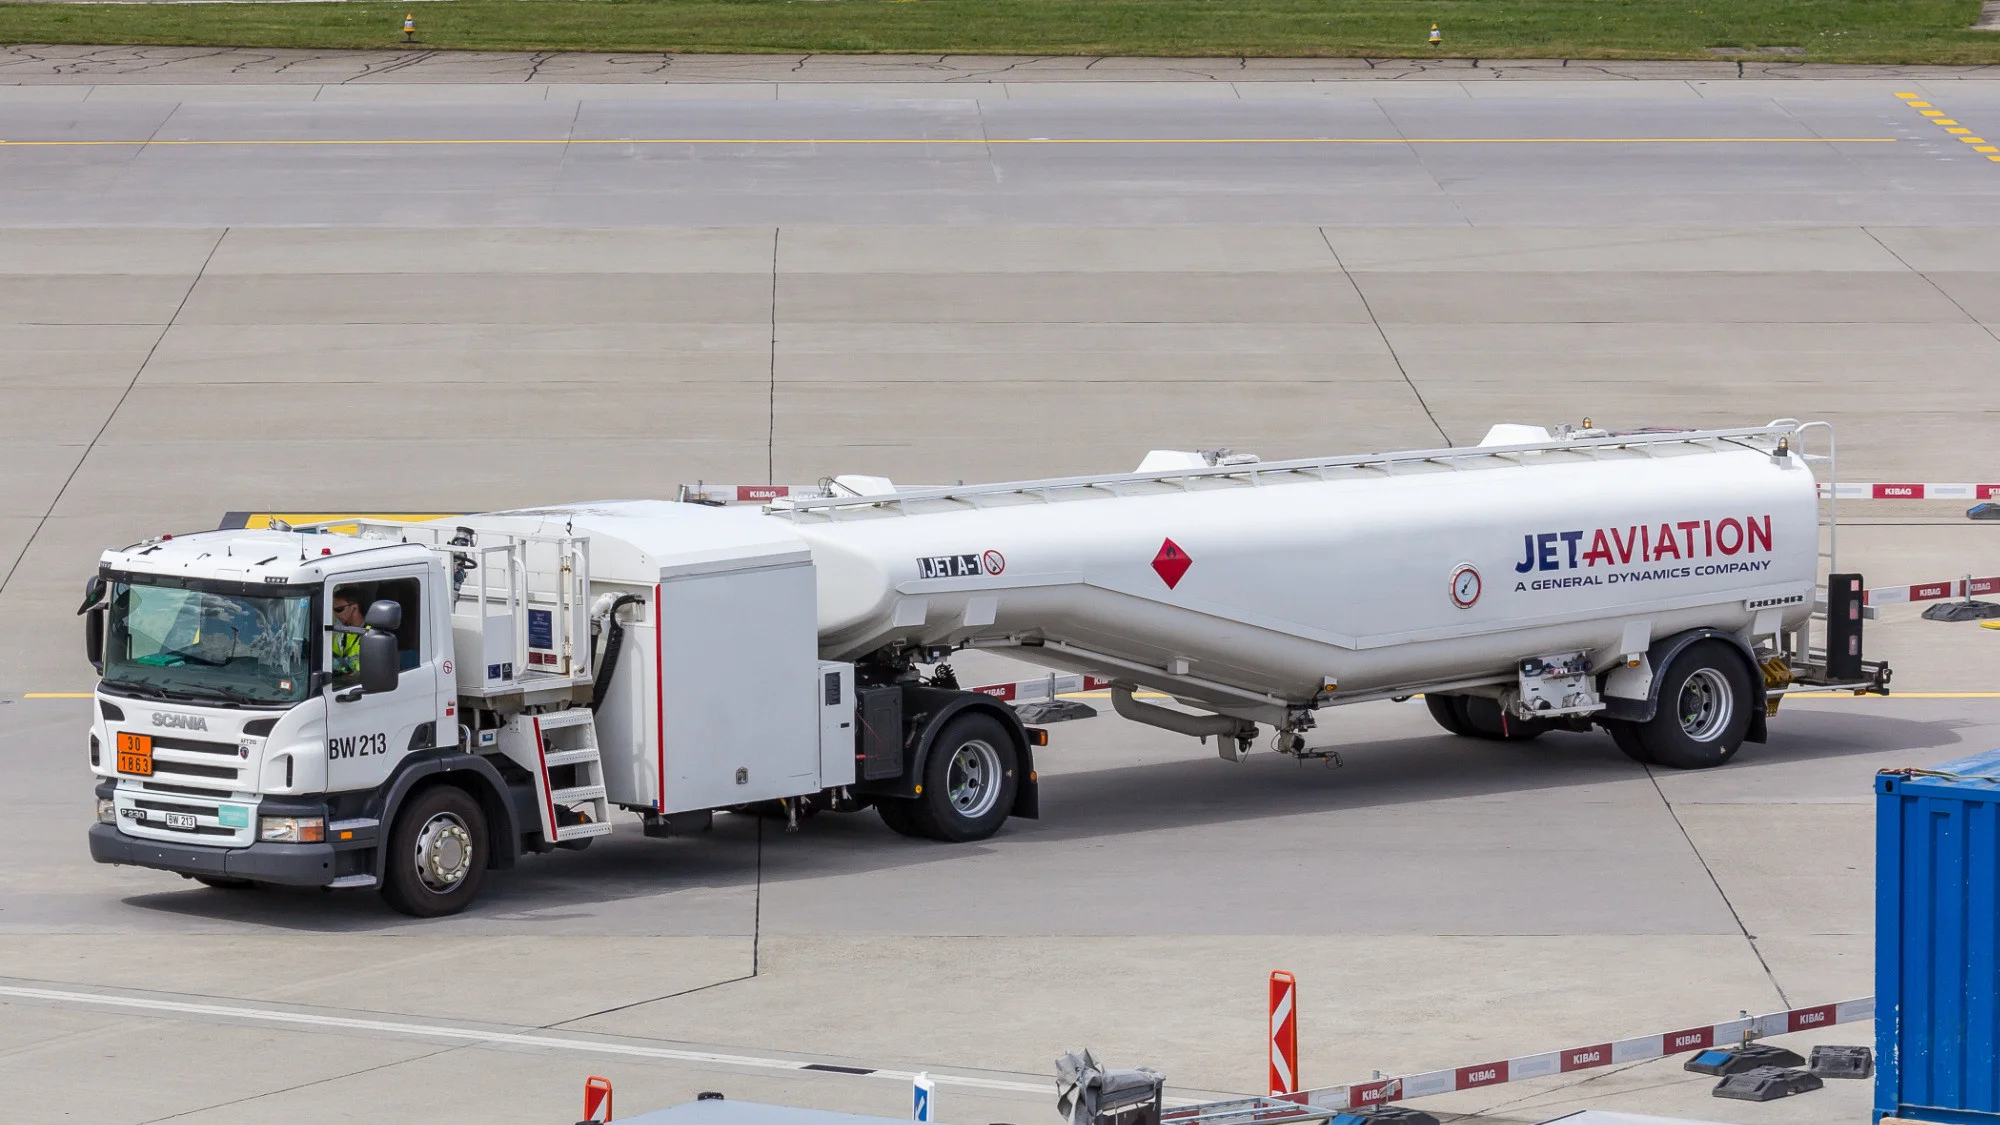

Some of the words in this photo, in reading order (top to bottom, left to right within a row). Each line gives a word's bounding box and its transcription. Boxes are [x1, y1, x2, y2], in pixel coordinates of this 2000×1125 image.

[749, 490, 777, 498] KIBAG
[1515, 530, 1583, 574] JET
[1582, 515, 1773, 568] AVIATION
[957, 554, 982, 575] A-1
[1514, 582, 1527, 592] A
[1531, 575, 1603, 591] GENERAL
[1608, 567, 1691, 584] DYNAMICS
[1695, 560, 1772, 576] COMPANY
[1919, 587, 1941, 596] KIBAG
[1970, 582, 1991, 591] KIBAG
[1749, 595, 1803, 608] ROHR
[152, 712, 208, 732] SCANIA
[127, 736, 141, 751] 30
[329, 738, 356, 760] BW
[359, 732, 387, 757] 213
[121, 756, 149, 773] 1863
[121, 809, 128, 817] P
[128, 810, 145, 819] 230
[168, 814, 179, 825] BW
[181, 816, 194, 827] 213
[1800, 1011, 1825, 1024] KIBAG
[1675, 1033, 1702, 1047] KIBAG
[1573, 1051, 1600, 1065] KIBAG
[1468, 1068, 1496, 1083] KIBAG
[1362, 1089, 1380, 1101] KIB
